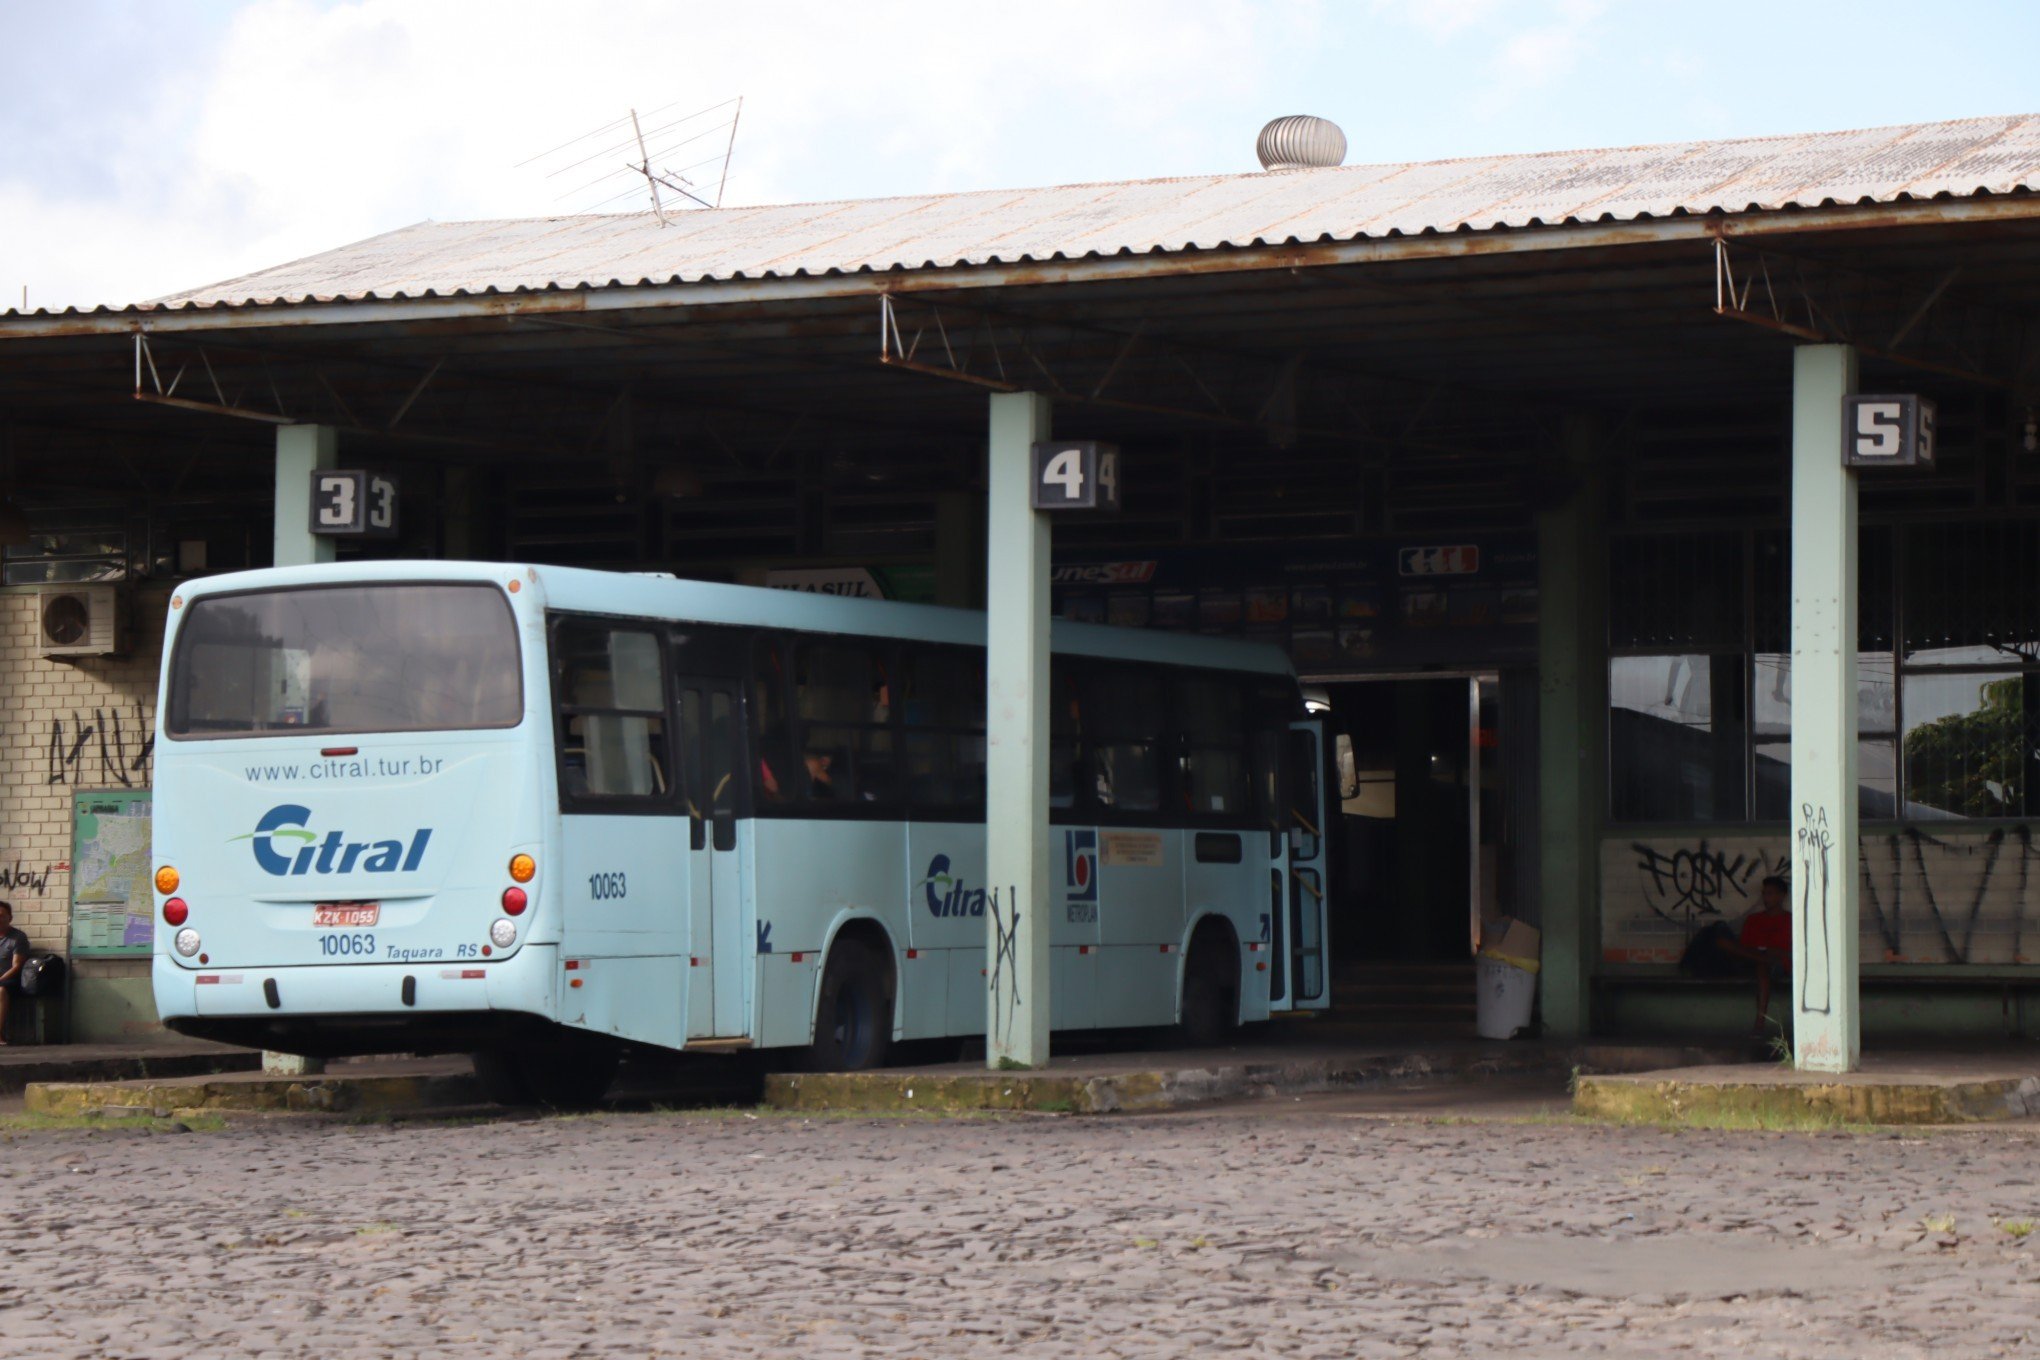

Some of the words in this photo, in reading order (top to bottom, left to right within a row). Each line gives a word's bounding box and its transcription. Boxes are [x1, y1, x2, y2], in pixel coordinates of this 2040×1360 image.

[1857, 403, 1900, 456] 5
[1919, 406, 1932, 460] 5
[1043, 449, 1084, 499] 4
[1098, 453, 1116, 501] 4
[320, 477, 355, 524] 3
[371, 475, 395, 528] 3
[245, 754, 444, 782] www.citral.tur.br
[252, 804, 434, 876] Citral
[589, 872, 627, 901] 10063
[926, 853, 987, 918] Citra
[319, 934, 376, 956] 10063
[387, 945, 444, 962] Taquara
[457, 943, 479, 957] RS
